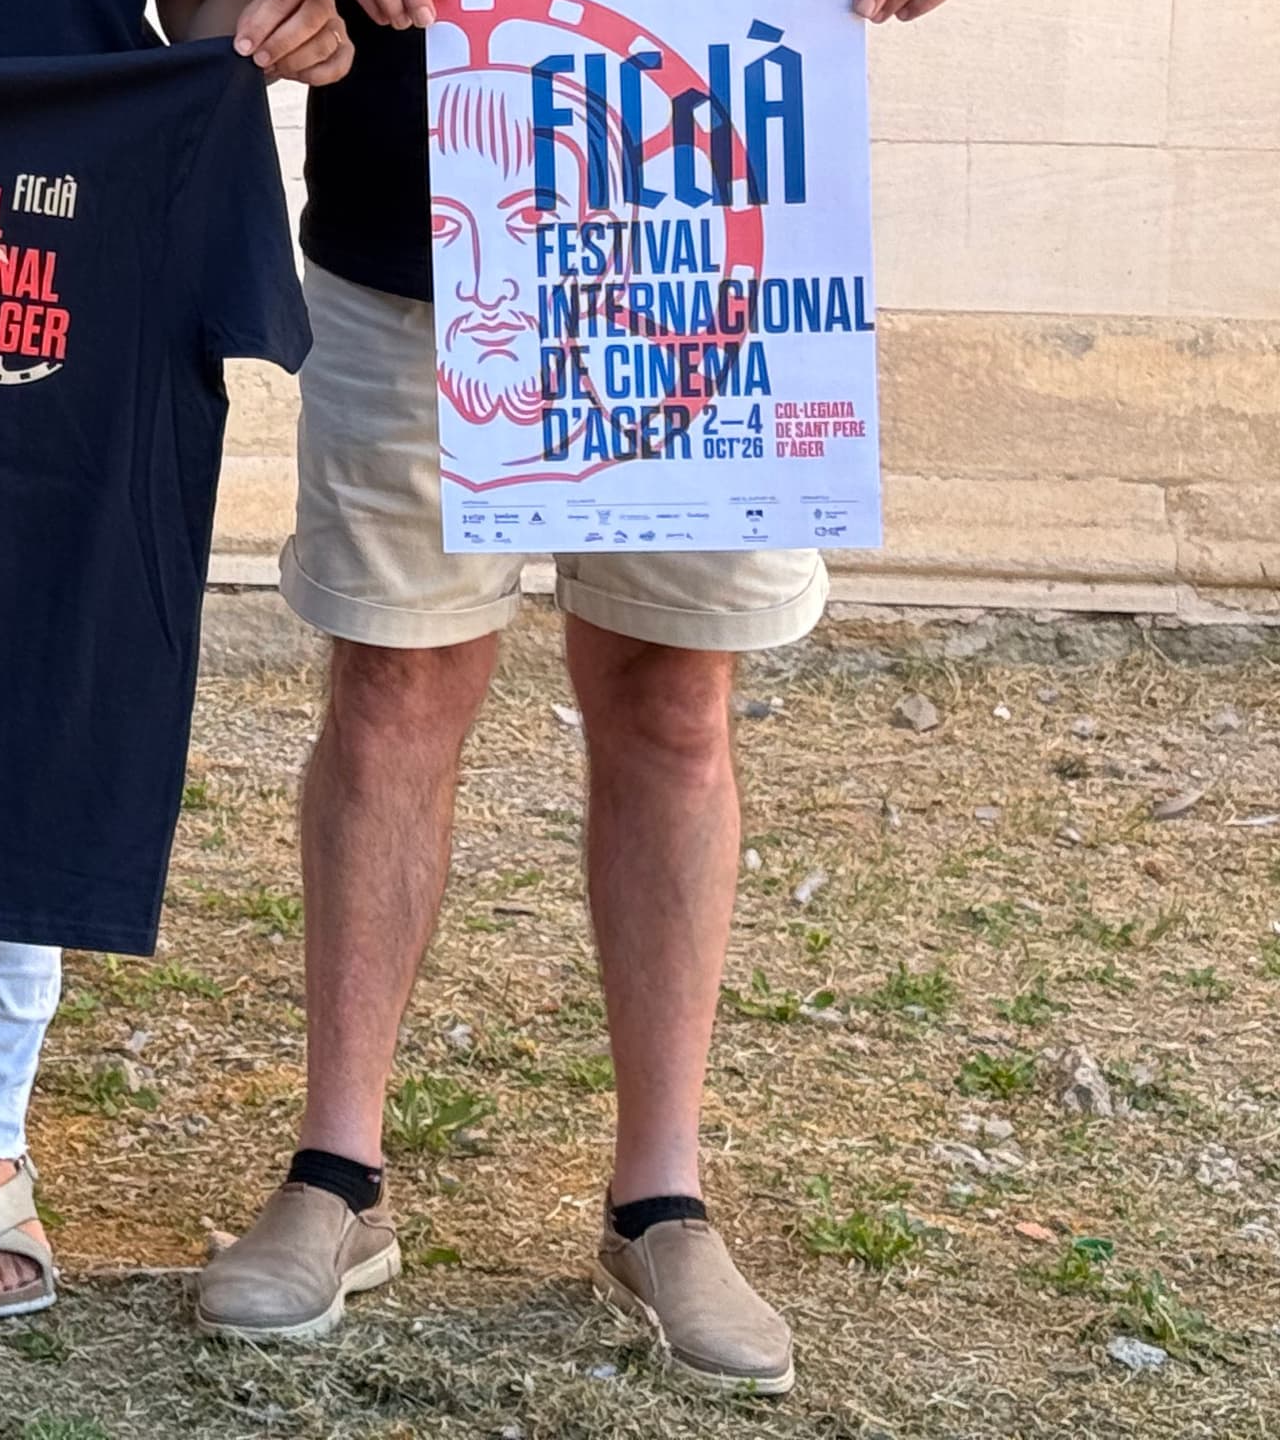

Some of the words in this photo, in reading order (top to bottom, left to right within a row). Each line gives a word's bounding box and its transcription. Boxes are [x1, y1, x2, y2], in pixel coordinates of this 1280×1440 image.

[536, 218, 720, 277] FESTIVAL
[538, 276, 875, 340] INTERNACIONAL
[541, 345, 591, 401] DE
[604, 341, 772, 399] CINEMA
[775, 421, 793, 438] DE
[795, 421, 830, 438] SANT
[833, 421, 866, 438] PERE
